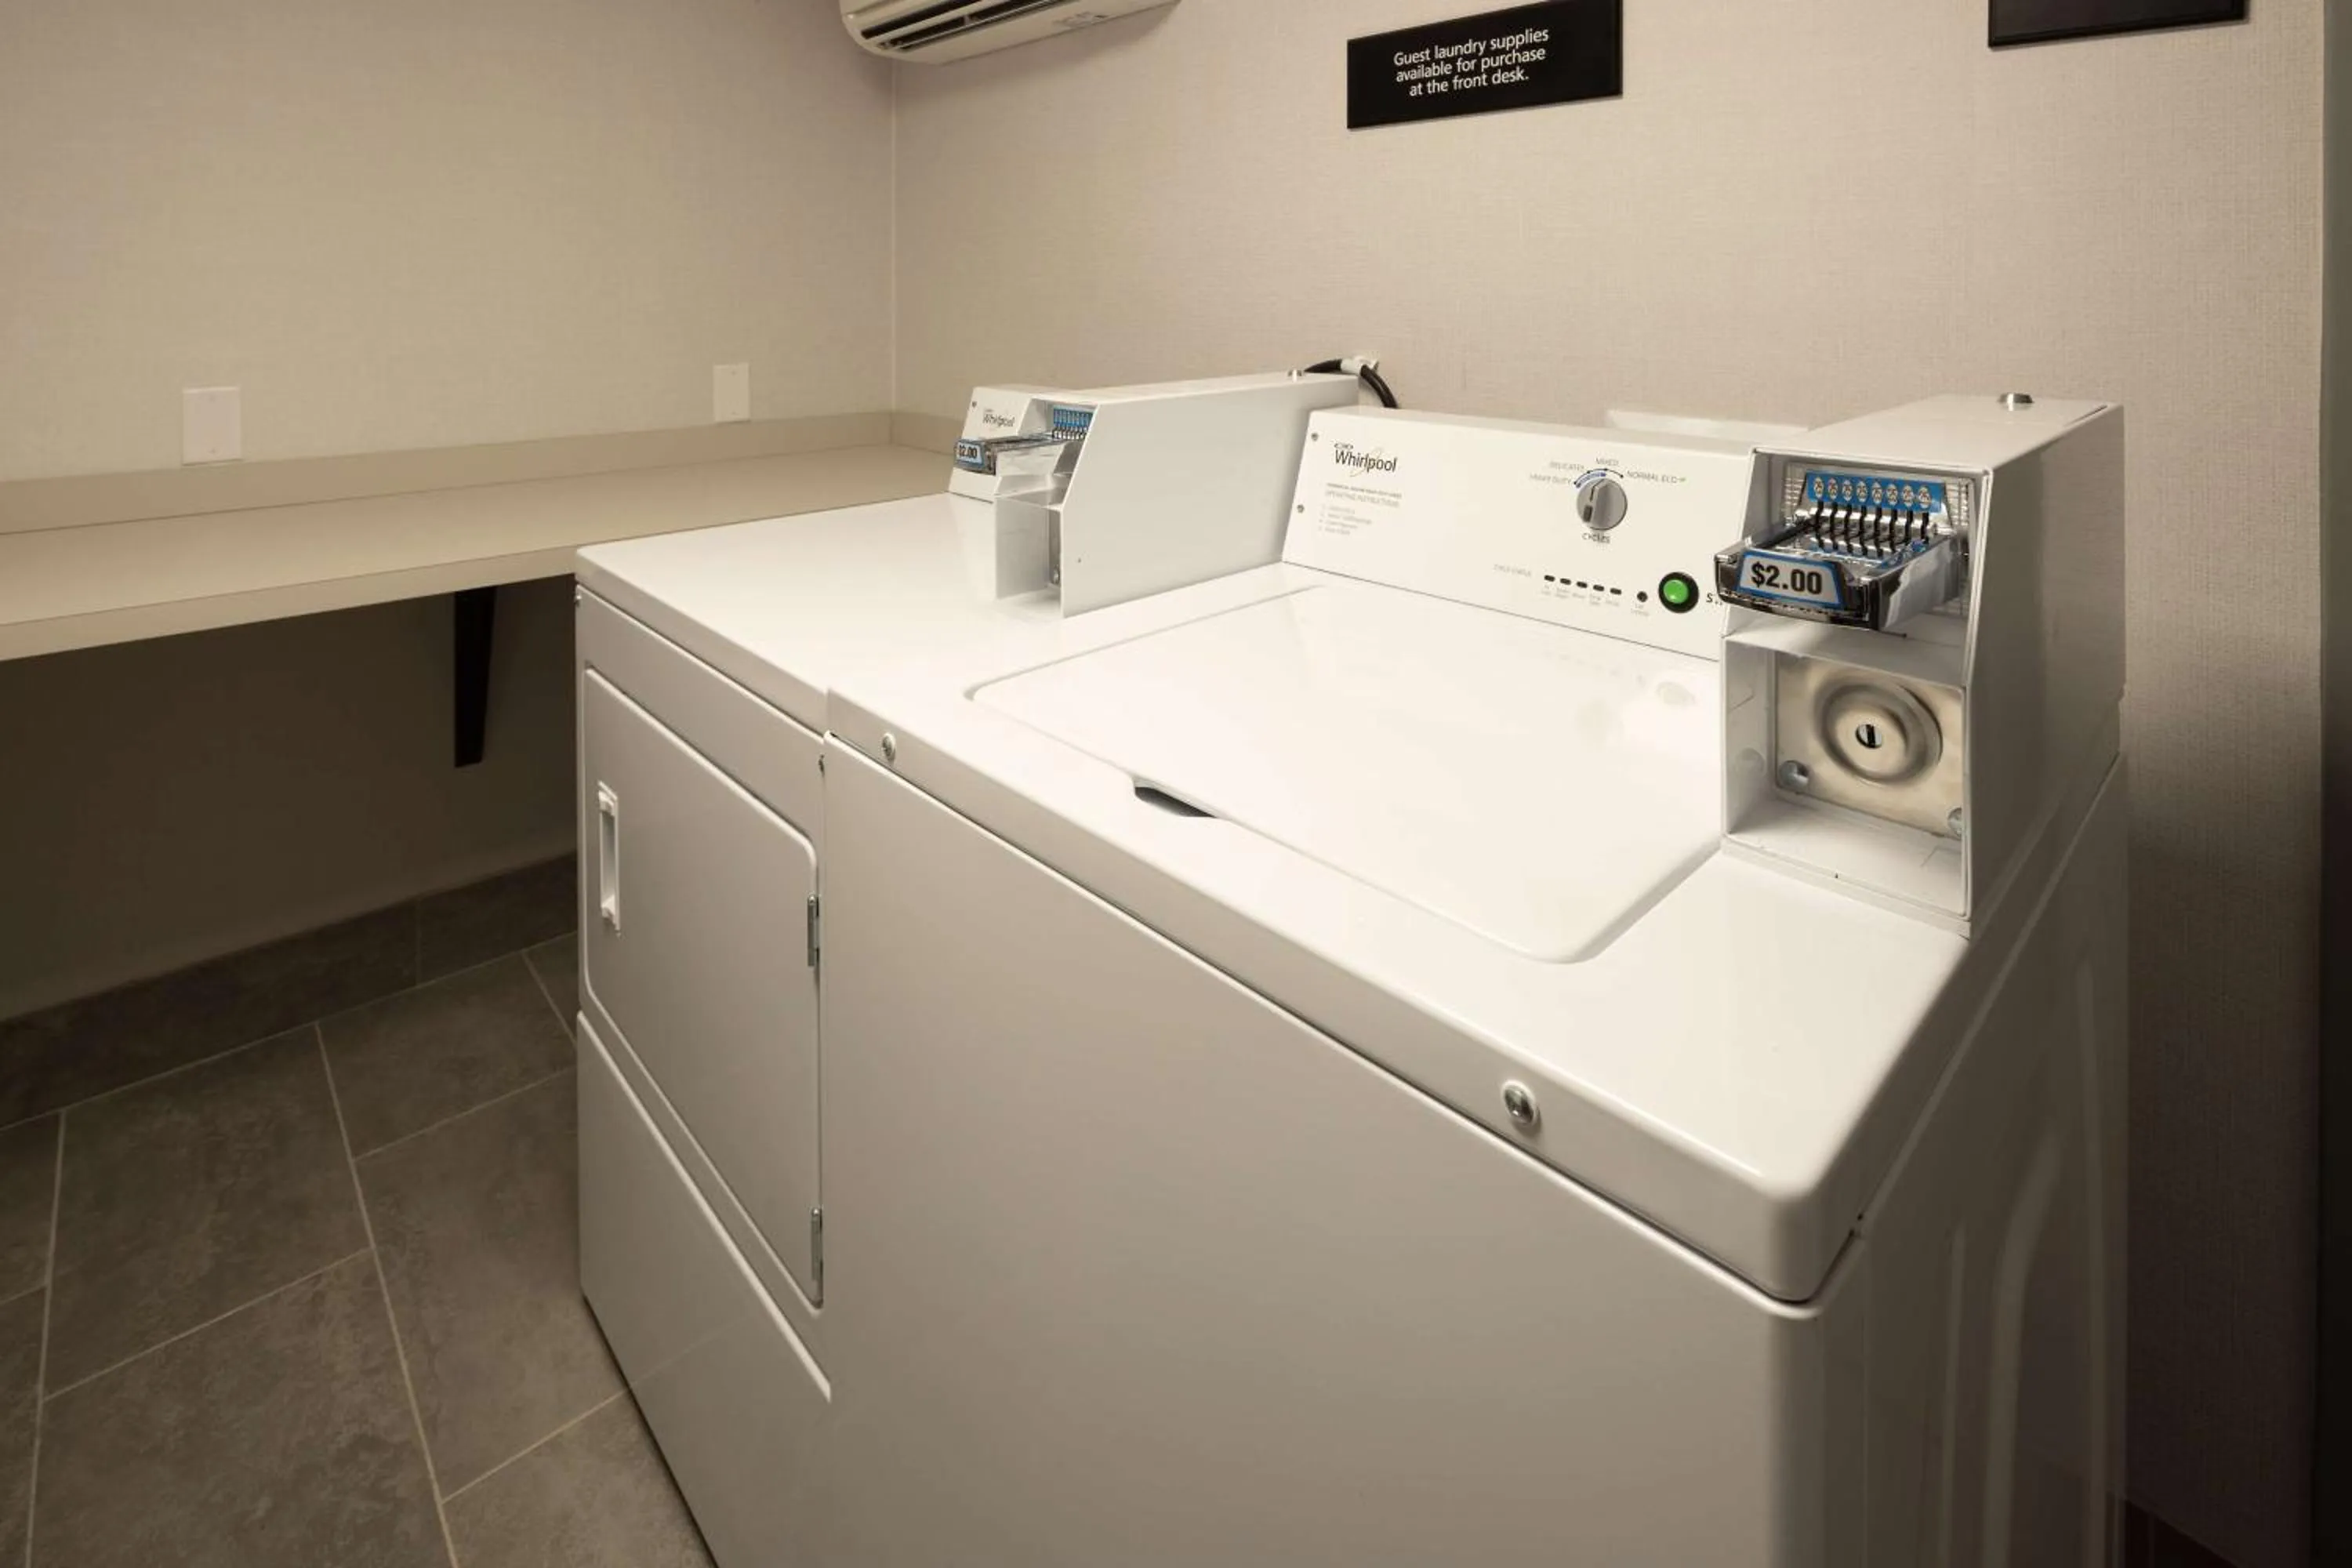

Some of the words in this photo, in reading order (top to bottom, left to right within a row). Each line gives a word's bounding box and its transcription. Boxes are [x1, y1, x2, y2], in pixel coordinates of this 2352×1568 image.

[1393, 48, 1431, 66] Guest
[1434, 38, 1487, 59] laundry
[1490, 27, 1549, 51] supplies
[1396, 60, 1453, 82] available
[1456, 57, 1478, 73] for
[1481, 48, 1546, 72] purchase
[1409, 82, 1423, 96] at
[1426, 78, 1450, 94] the
[1452, 73, 1489, 90] front
[1491, 65, 1530, 85] desk.
[1334, 448, 1398, 474] Whirlpool
[1750, 561, 1822, 596] $2.00
